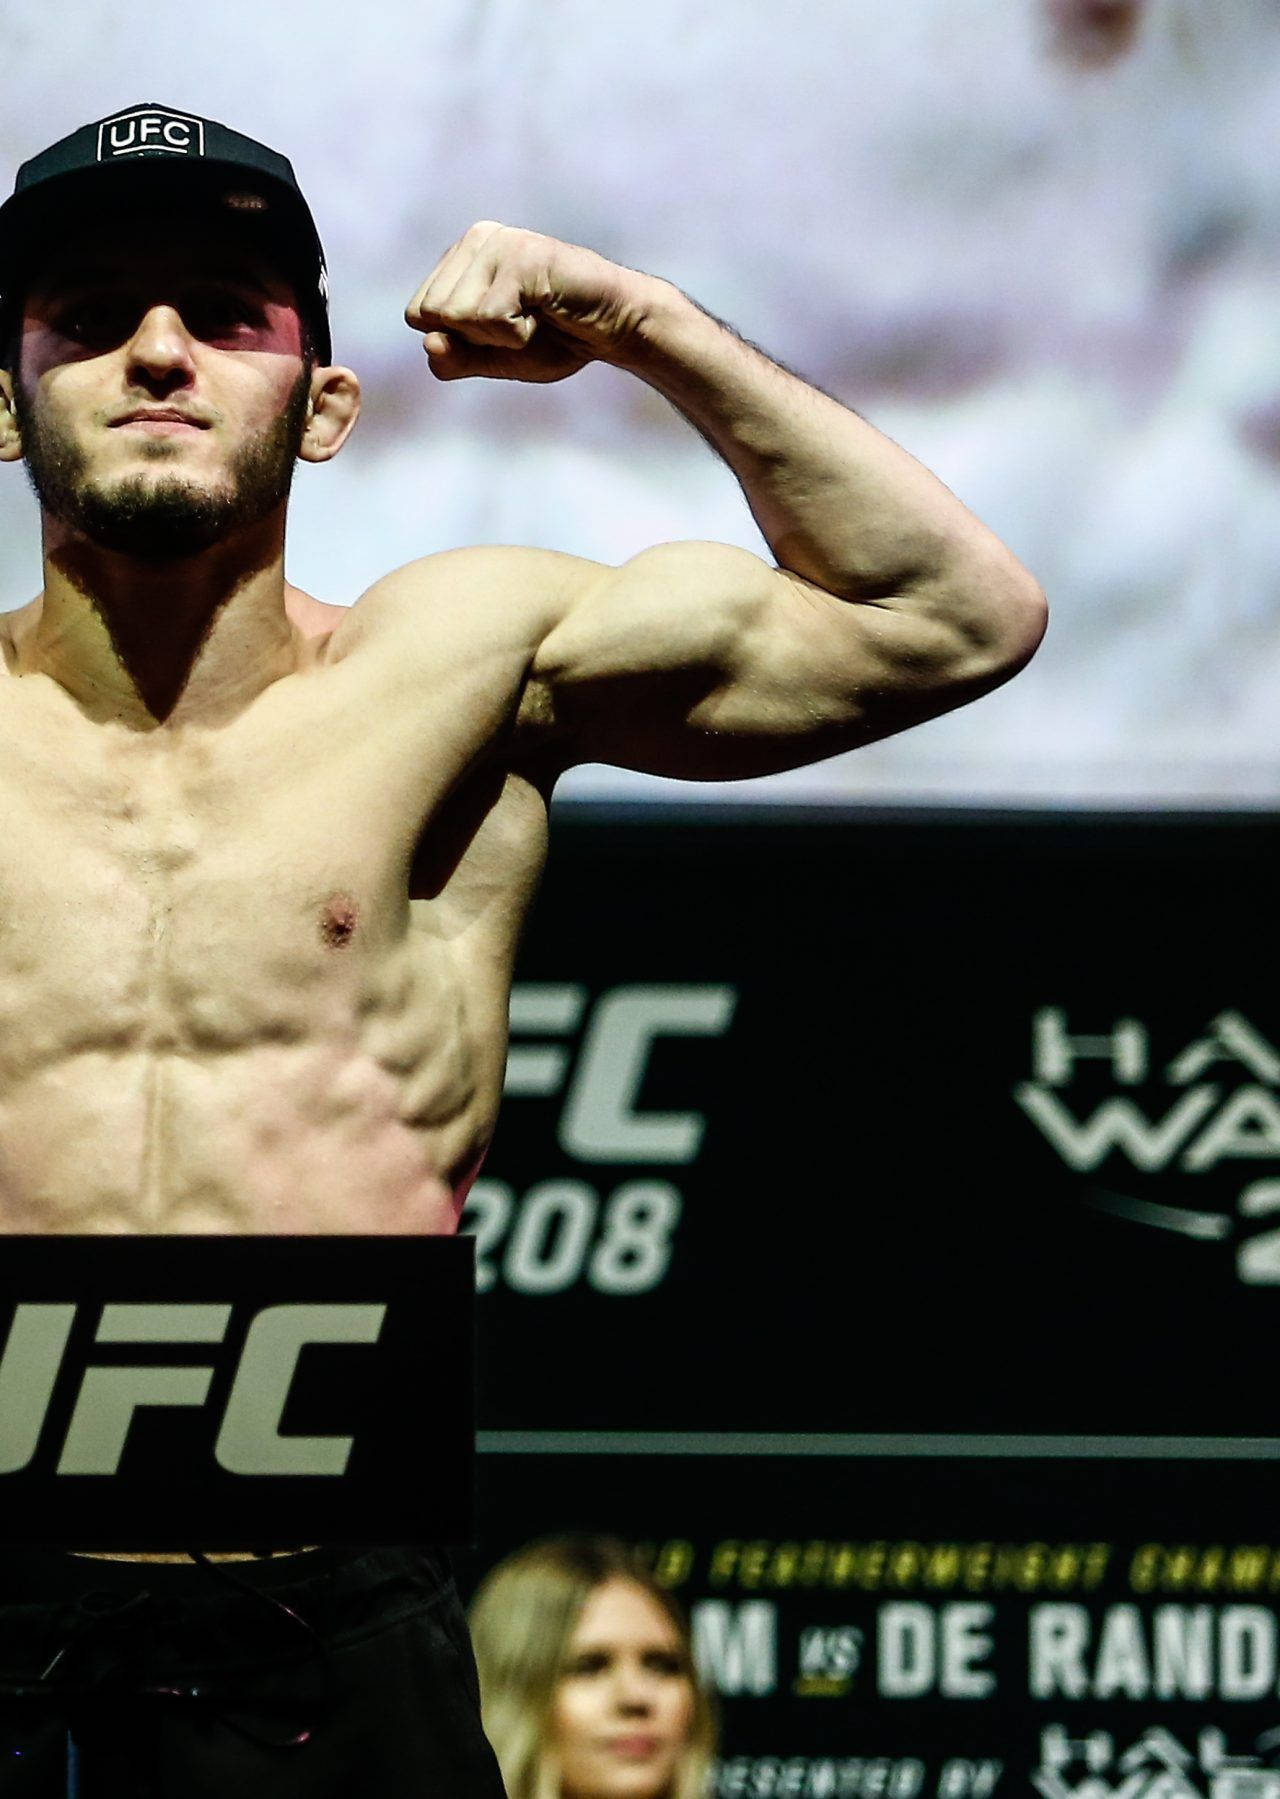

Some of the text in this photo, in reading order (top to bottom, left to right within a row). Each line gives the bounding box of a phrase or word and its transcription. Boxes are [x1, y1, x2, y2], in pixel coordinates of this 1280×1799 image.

[110, 118, 190, 147] UFC
[876, 1599, 999, 1699] DE
[1027, 1602, 1277, 1700] RAND
[708, 1756, 927, 1799] ESENTED
